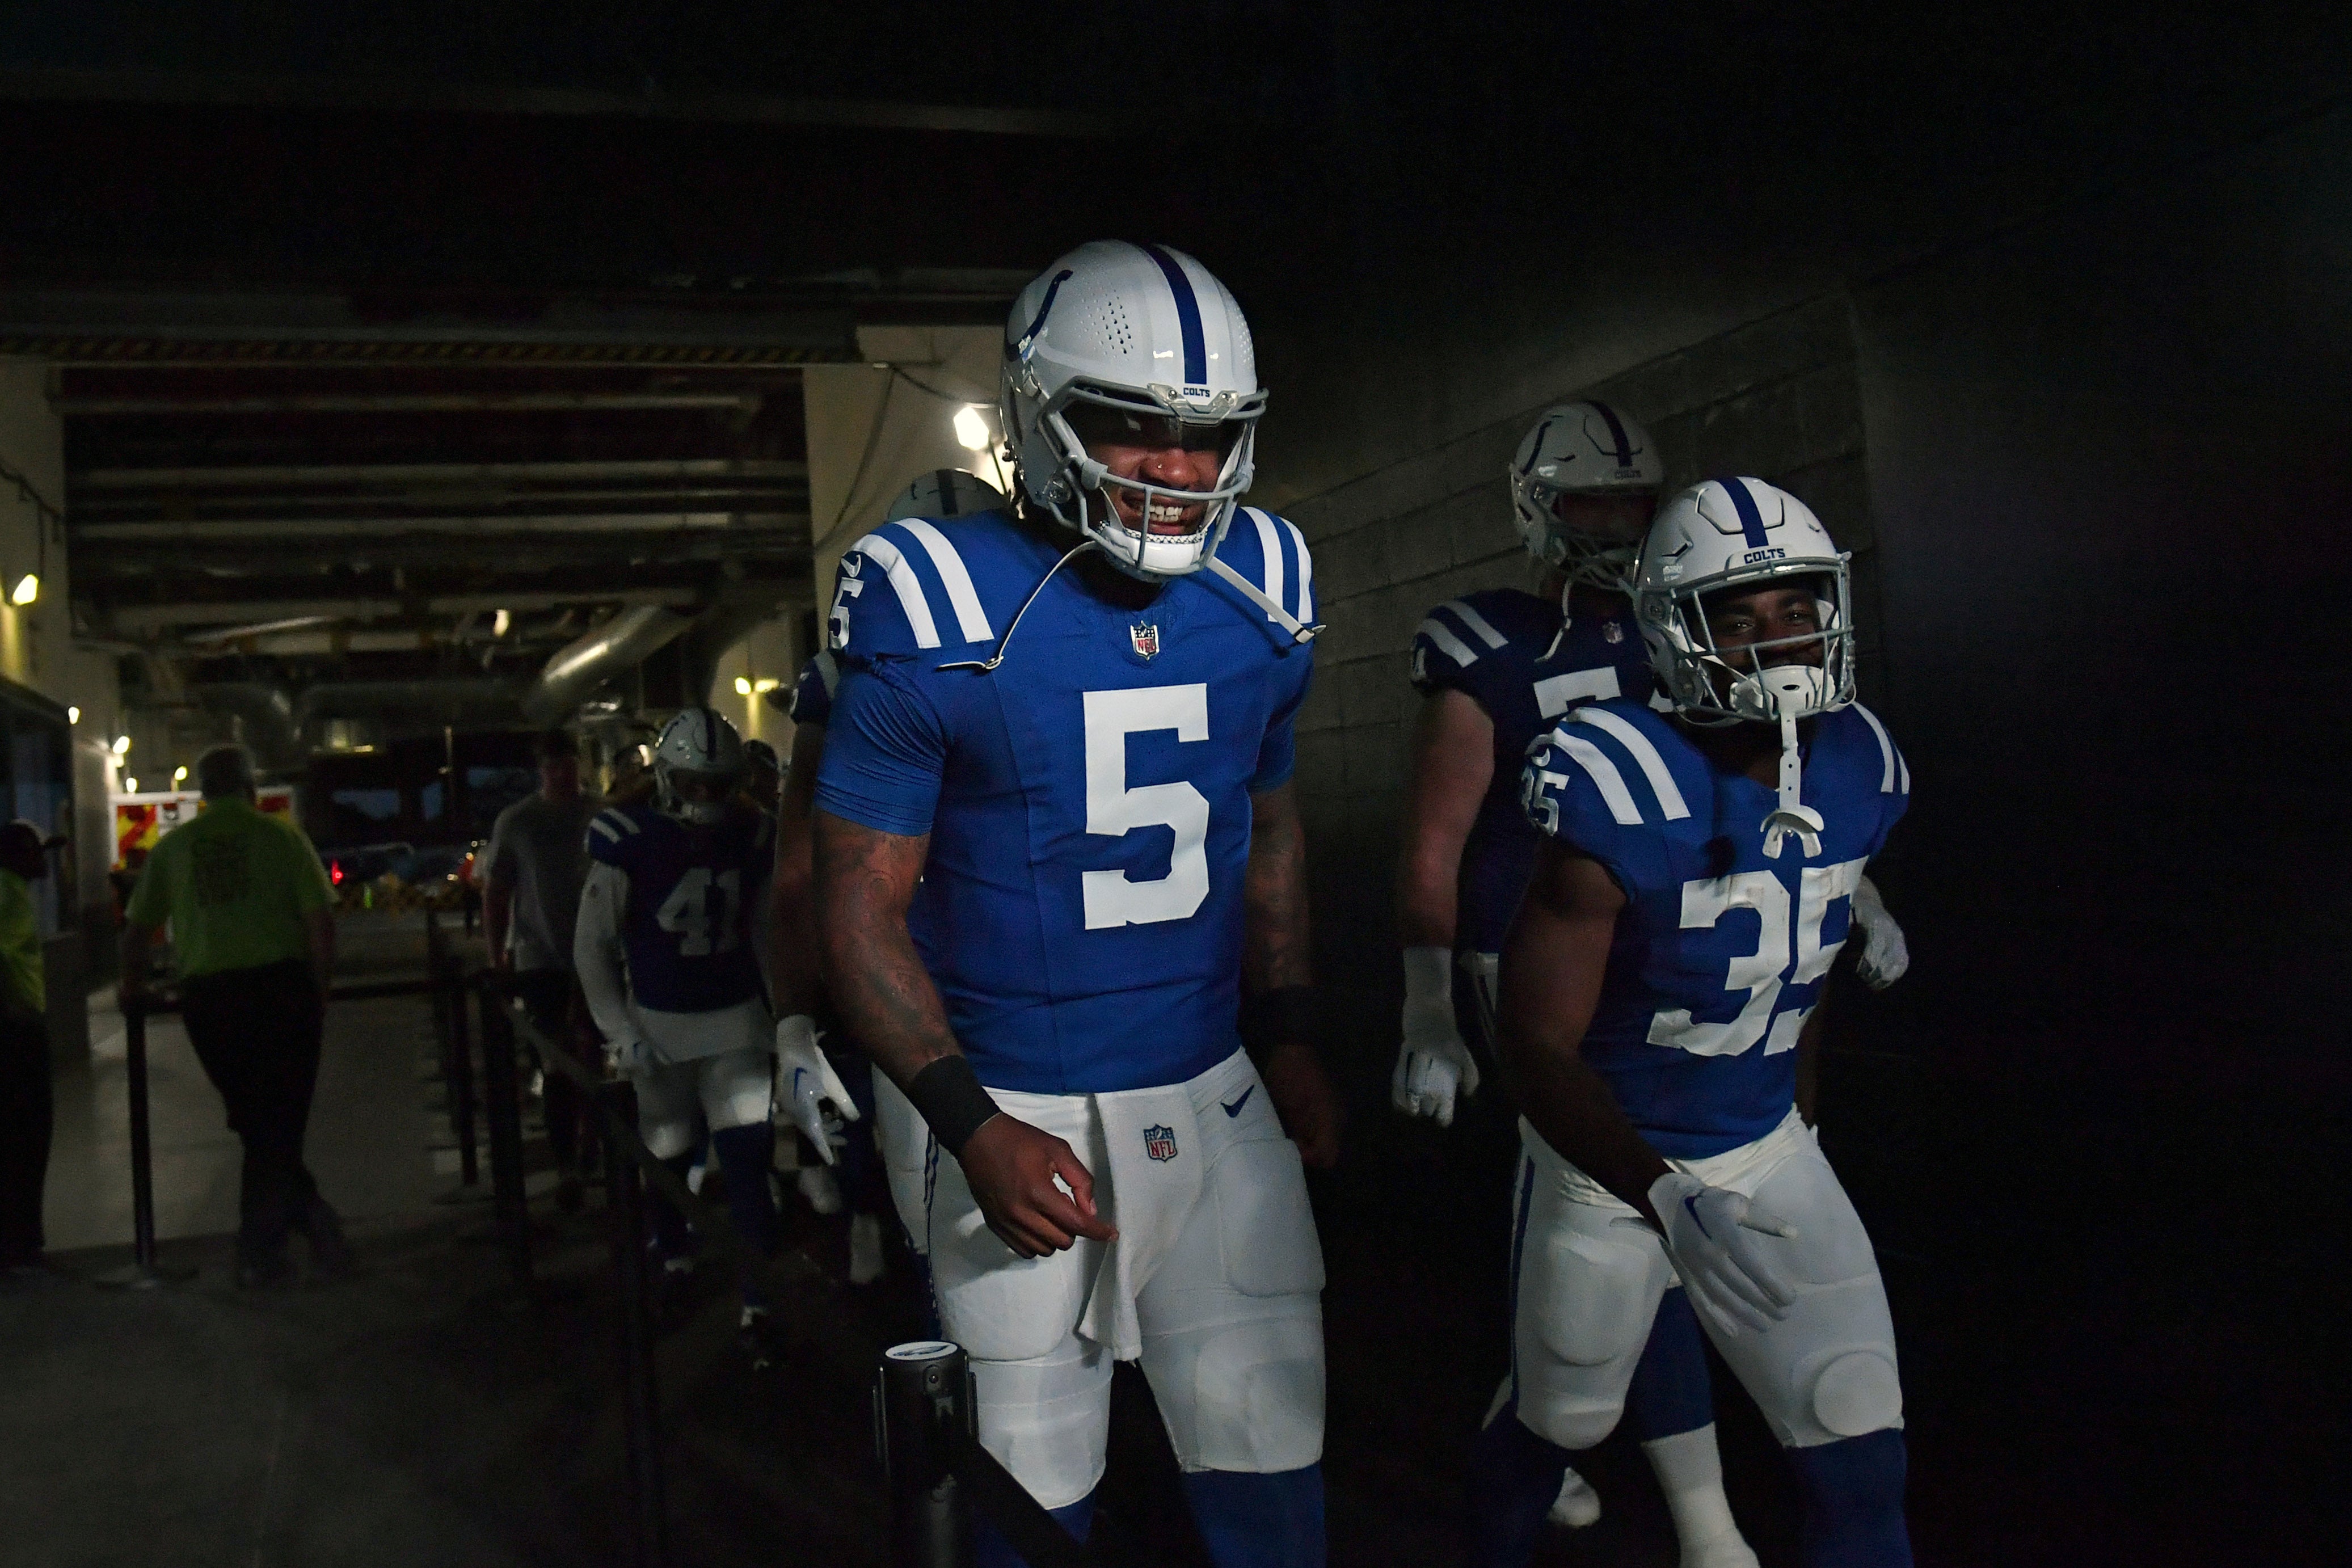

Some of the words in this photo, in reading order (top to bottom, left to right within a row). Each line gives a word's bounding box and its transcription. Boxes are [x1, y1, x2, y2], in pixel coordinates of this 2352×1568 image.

[1183, 387, 1209, 397] COLTS
[1744, 549, 1785, 563] COLTS
[829, 576, 864, 649] 5
[1082, 683, 1209, 930] 5
[656, 867, 740, 956] 41
[1646, 855, 1869, 1056] 35
[1149, 1140, 1174, 1157] NFL
